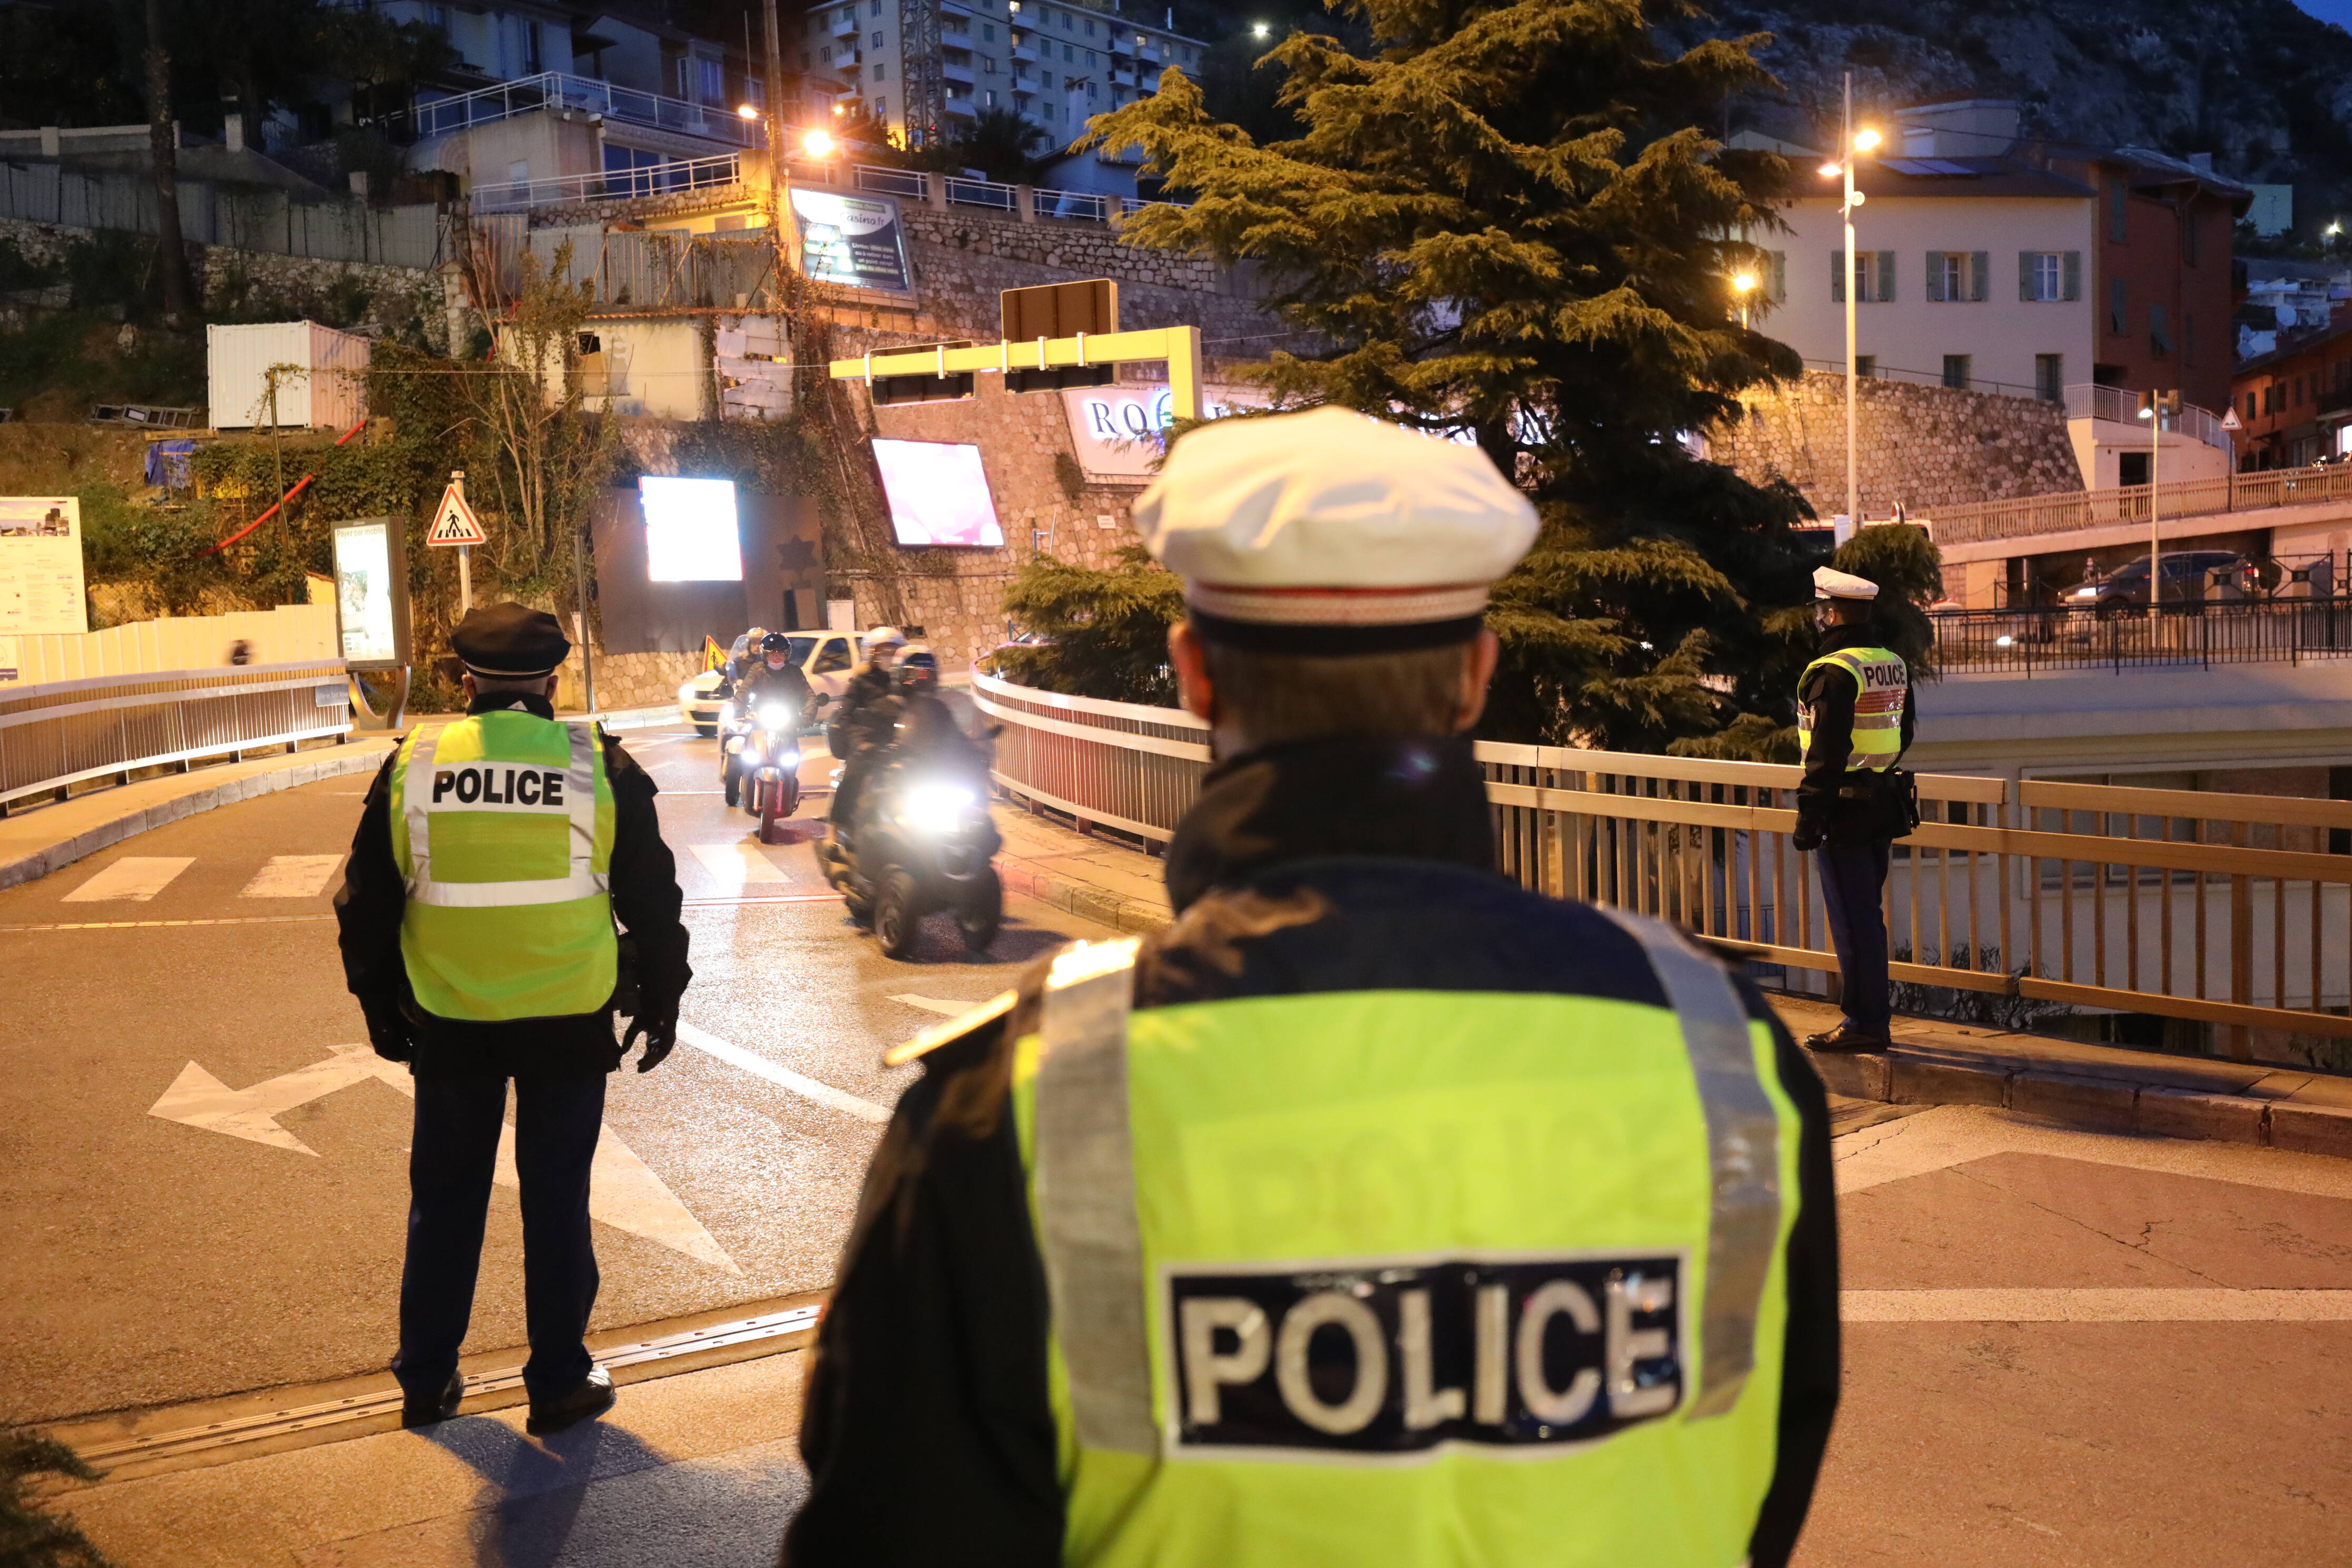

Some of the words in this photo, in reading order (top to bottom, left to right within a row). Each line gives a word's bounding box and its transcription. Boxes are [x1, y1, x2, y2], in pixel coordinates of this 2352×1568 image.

[337, 530, 352, 539] Payez
[1863, 664, 1906, 688] POLICE
[433, 768, 563, 806] POLICE
[1180, 1278, 1677, 1436] POLICE
